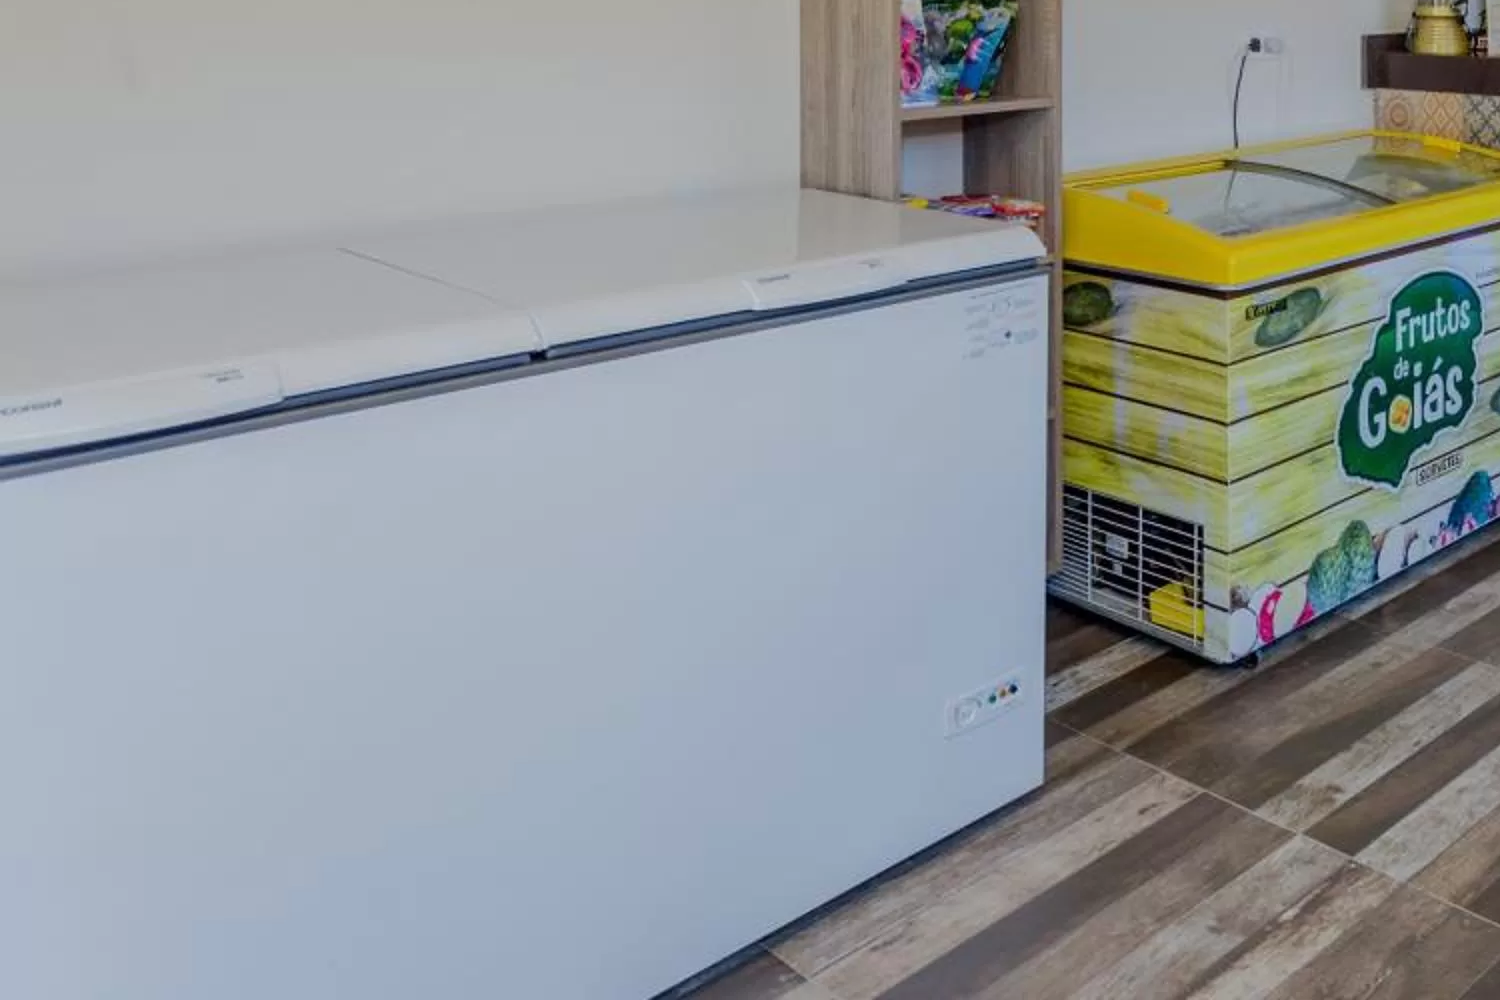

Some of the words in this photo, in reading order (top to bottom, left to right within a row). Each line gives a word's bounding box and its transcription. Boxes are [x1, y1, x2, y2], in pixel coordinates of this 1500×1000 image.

[1395, 297, 1471, 352] Frutos
[1393, 356, 1409, 380] de
[1358, 355, 1464, 448] Goiás
